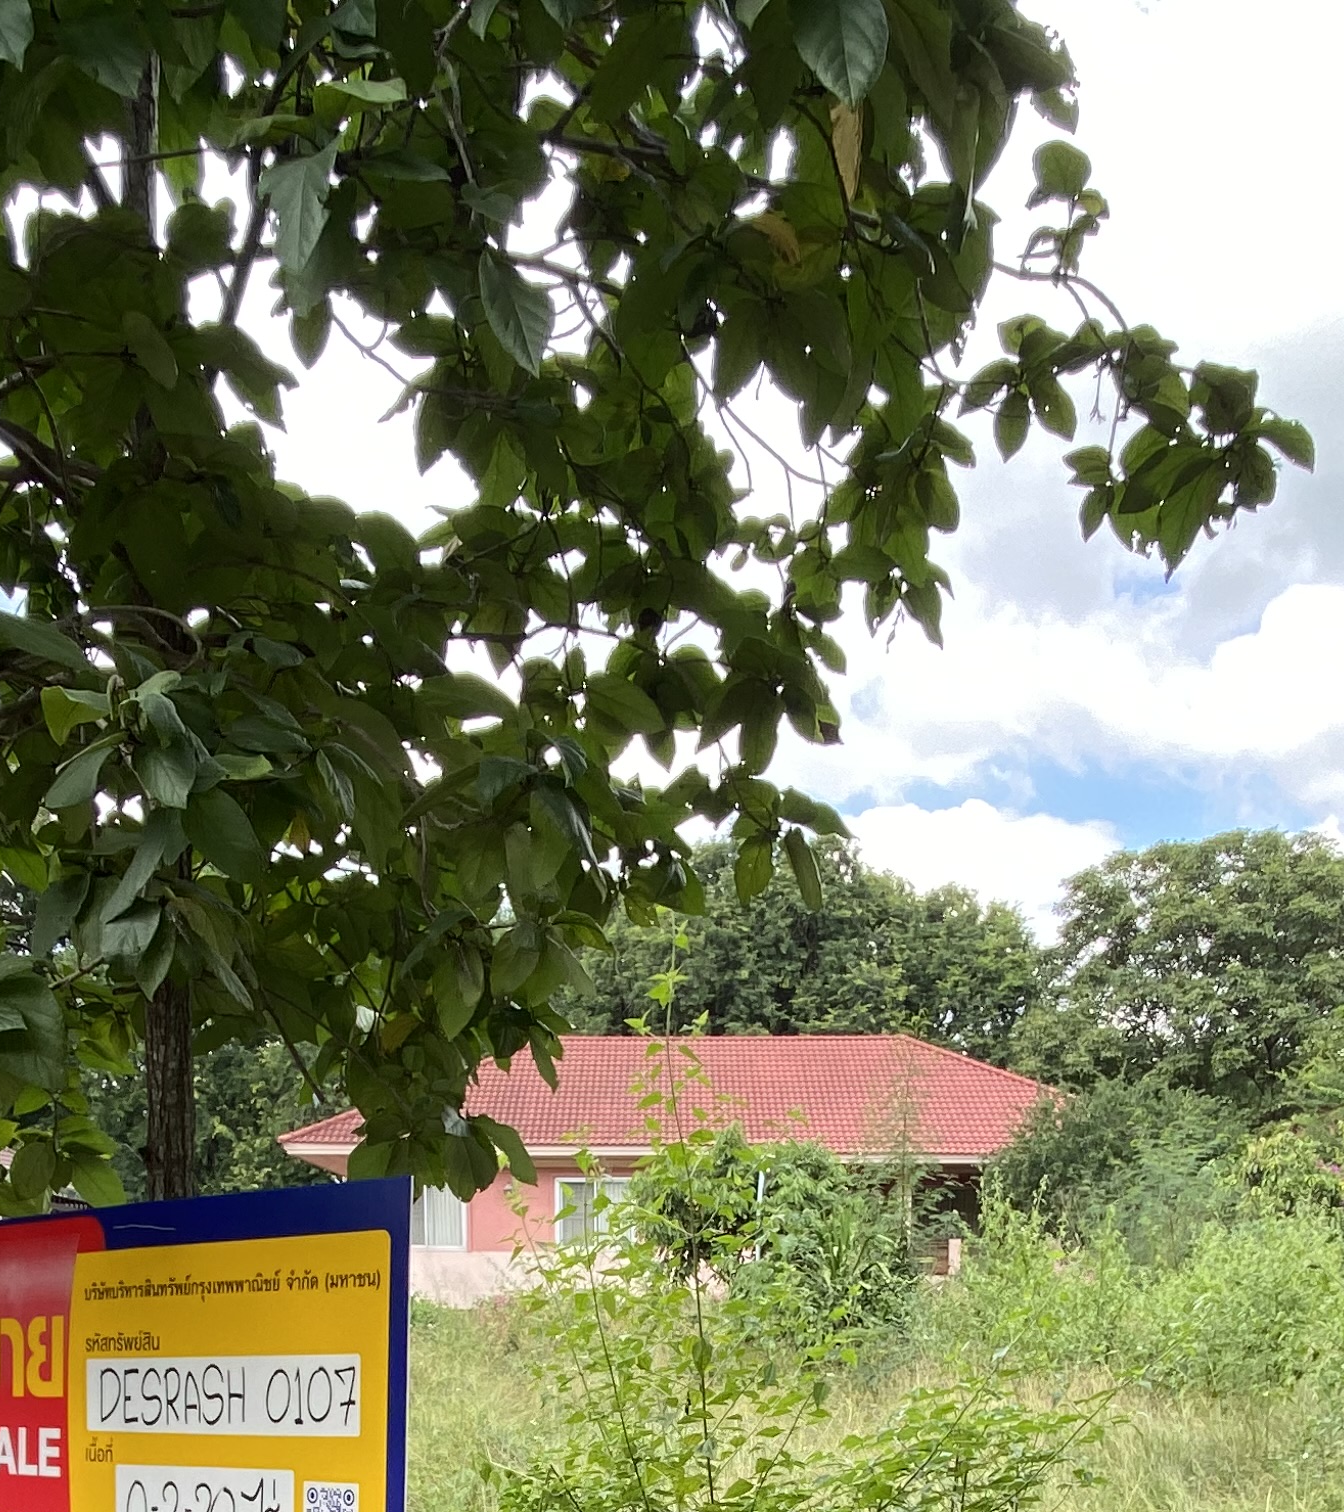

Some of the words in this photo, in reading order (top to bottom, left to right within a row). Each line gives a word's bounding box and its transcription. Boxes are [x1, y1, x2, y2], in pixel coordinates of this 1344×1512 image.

[286, 1268, 319, 1291] จำกัด
[324, 1268, 382, 1294] (มหาชน)
[85, 1330, 161, 1353] รหัสทรัพย์สิน
[100, 1364, 246, 1426] DESRASH
[265, 1366, 357, 1427] 0107
